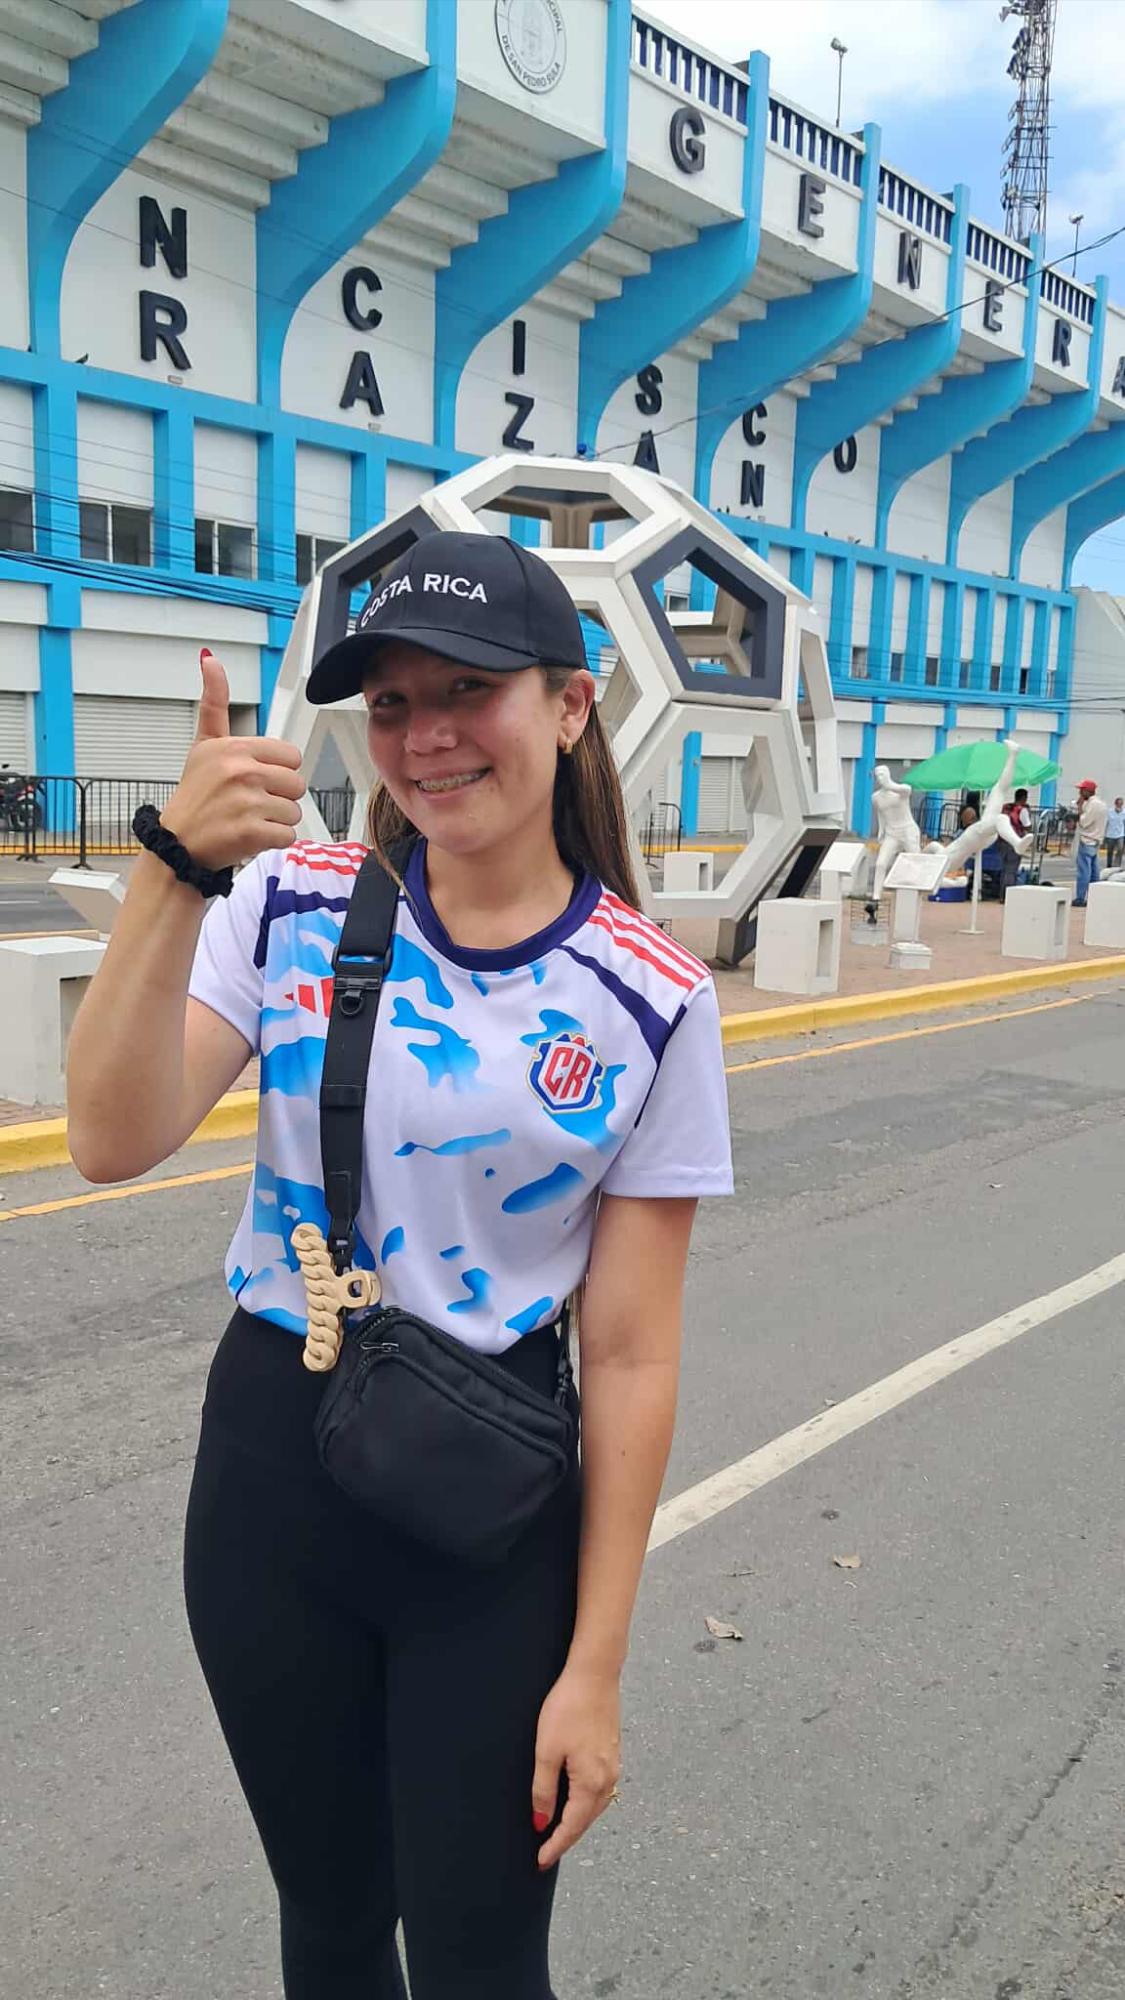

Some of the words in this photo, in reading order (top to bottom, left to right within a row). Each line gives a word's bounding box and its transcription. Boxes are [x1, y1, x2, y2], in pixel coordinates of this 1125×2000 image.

[508, 52, 523, 76] SAN
[670, 106, 706, 175] G
[799, 173, 826, 239] E
[898, 231, 923, 290] N
[983, 280, 1004, 332] E
[1052, 318, 1072, 367] R
[139, 195, 188, 279] N
[342, 266, 383, 331] C
[512, 320, 526, 375] I
[635, 364, 663, 416] S
[742, 402, 768, 446] C
[139, 290, 192, 371] R
[339, 351, 385, 416] A
[502, 392, 535, 451] Z
[740, 460, 765, 507] N
[360, 575, 414, 628] COSTA
[422, 573, 488, 603] RICA
[543, 1046, 592, 1100] CR
